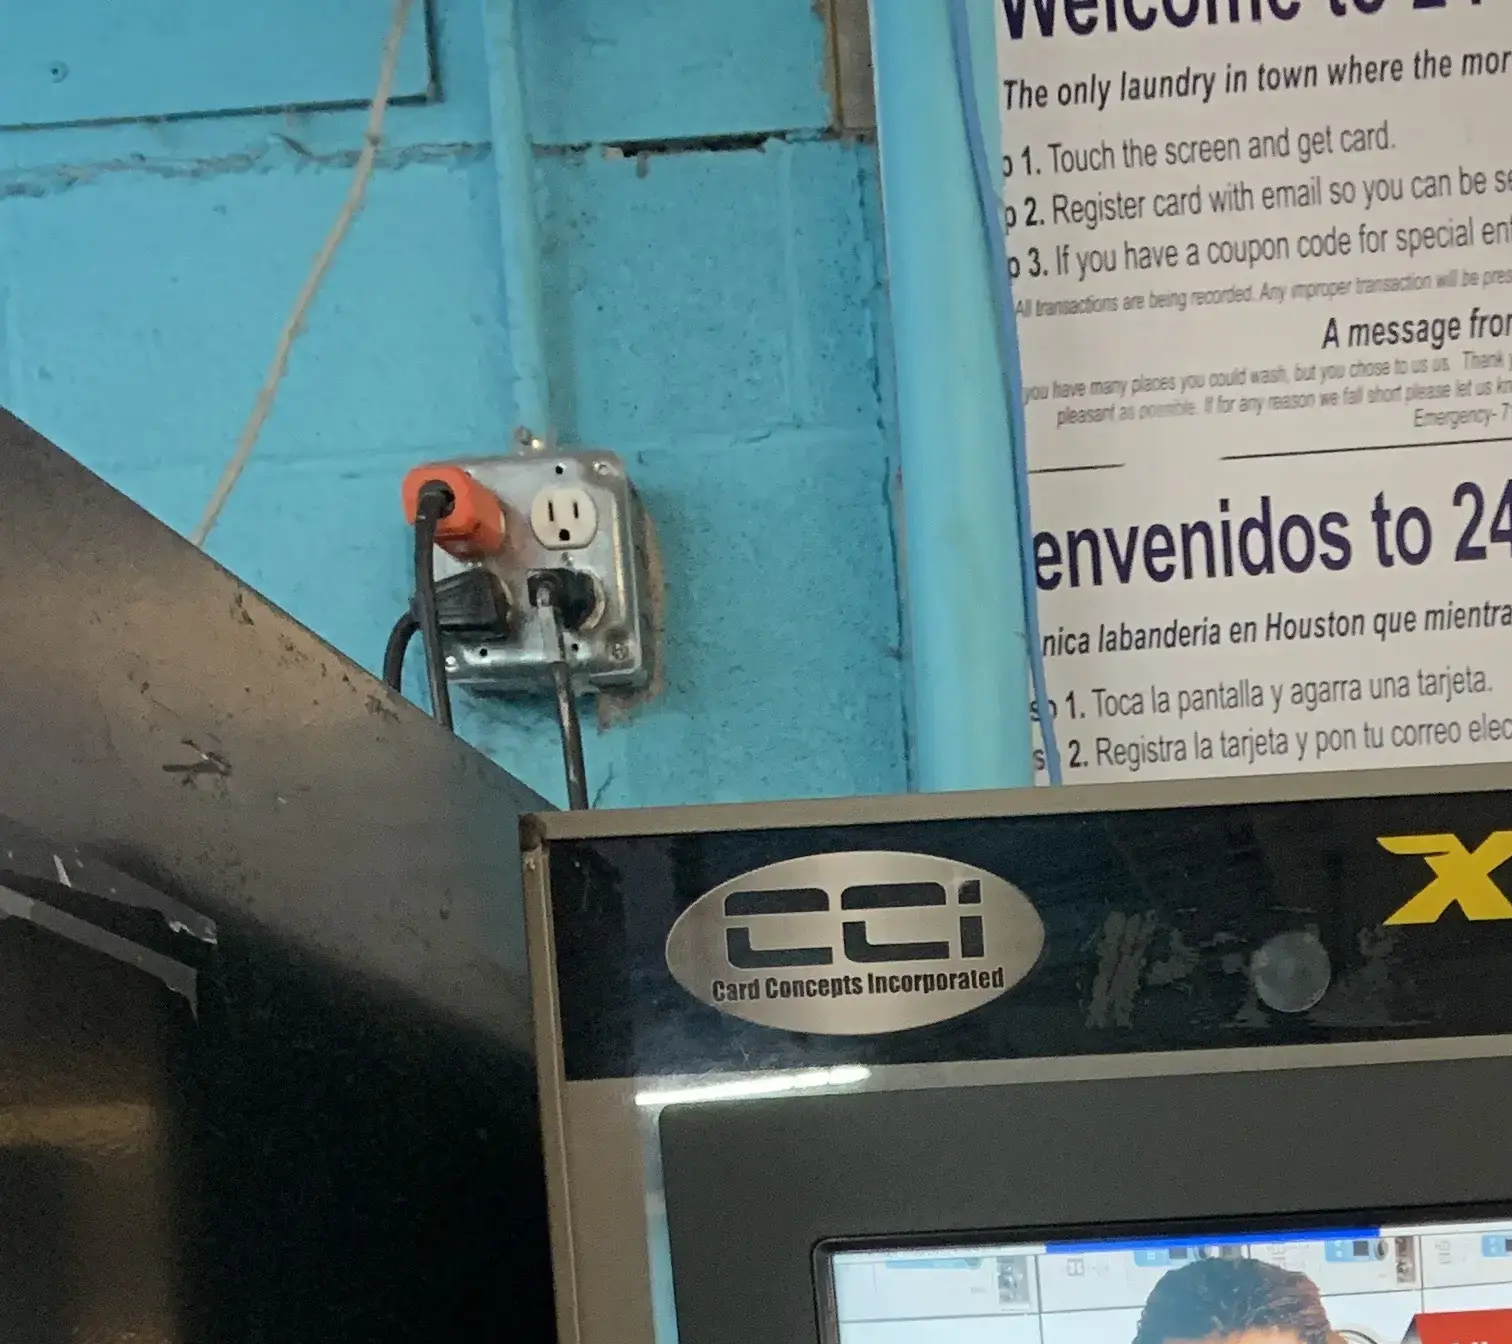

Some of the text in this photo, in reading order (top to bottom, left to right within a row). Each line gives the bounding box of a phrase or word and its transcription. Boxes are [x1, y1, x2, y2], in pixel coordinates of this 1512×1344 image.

[1002, 78, 1048, 110] The
[1057, 72, 1111, 111] only
[1119, 65, 1216, 104] laundry
[1257, 63, 1317, 92] town
[1326, 53, 1403, 86] where
[1413, 48, 1452, 80] the
[1046, 141, 1115, 173] Touch
[1121, 137, 1158, 168] the
[1164, 137, 1241, 165] screen
[1247, 126, 1291, 160] and
[1297, 125, 1334, 164] get
[1051, 190, 1146, 231] Register
[1152, 183, 1202, 217] card
[1207, 180, 1254, 213] with
[1261, 175, 1322, 210] email
[1361, 178, 1404, 211] you
[1410, 173, 1452, 200] can
[1075, 249, 1117, 282] you
[1123, 239, 1179, 270] have
[1206, 236, 1290, 269] coupon
[1296, 224, 1352, 258] code
[1357, 222, 1389, 254] for
[1395, 215, 1474, 258] special
[1347, 316, 1461, 350] message
[1370, 490, 1432, 568] to
[1097, 616, 1221, 653] labanderia
[1264, 610, 1365, 642] Houston
[1372, 610, 1417, 642] que
[1090, 687, 1144, 717] Toca
[1177, 678, 1264, 720] pantalla
[1290, 678, 1362, 712] agarra
[1369, 675, 1410, 700] una
[1095, 735, 1187, 772] Registra
[1219, 726, 1289, 765] tarjeta
[1315, 727, 1356, 759] pon
[1390, 720, 1461, 748] correo
[711, 966, 1004, 1002] Card Concepts Incorporated
